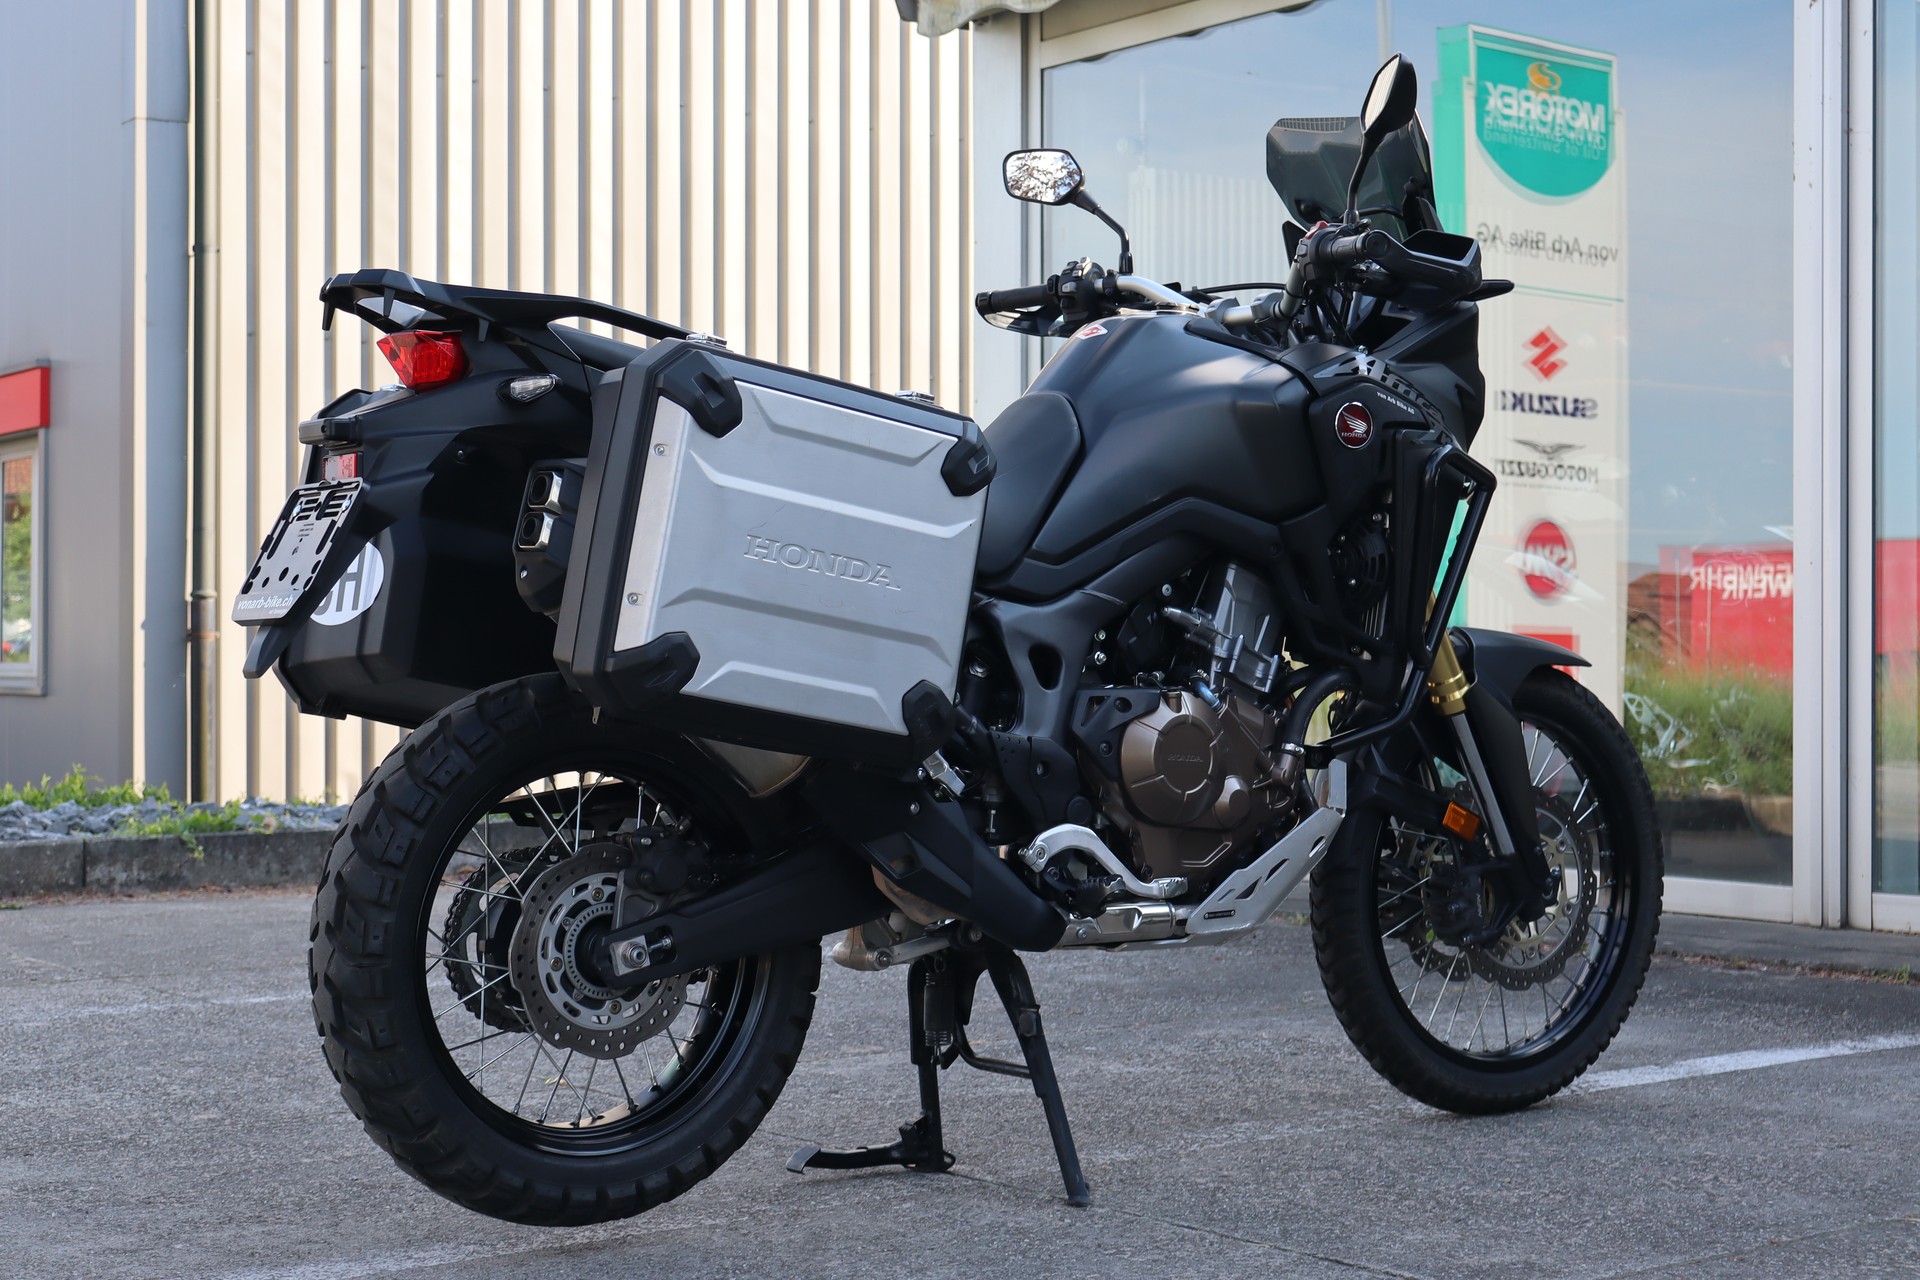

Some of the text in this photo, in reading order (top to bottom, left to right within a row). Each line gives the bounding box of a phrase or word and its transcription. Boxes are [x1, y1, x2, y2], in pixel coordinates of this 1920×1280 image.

[1341, 431, 1368, 439] HONDA
[743, 533, 902, 592] HONDA
[237, 593, 294, 611] vonarb-bike.ch
